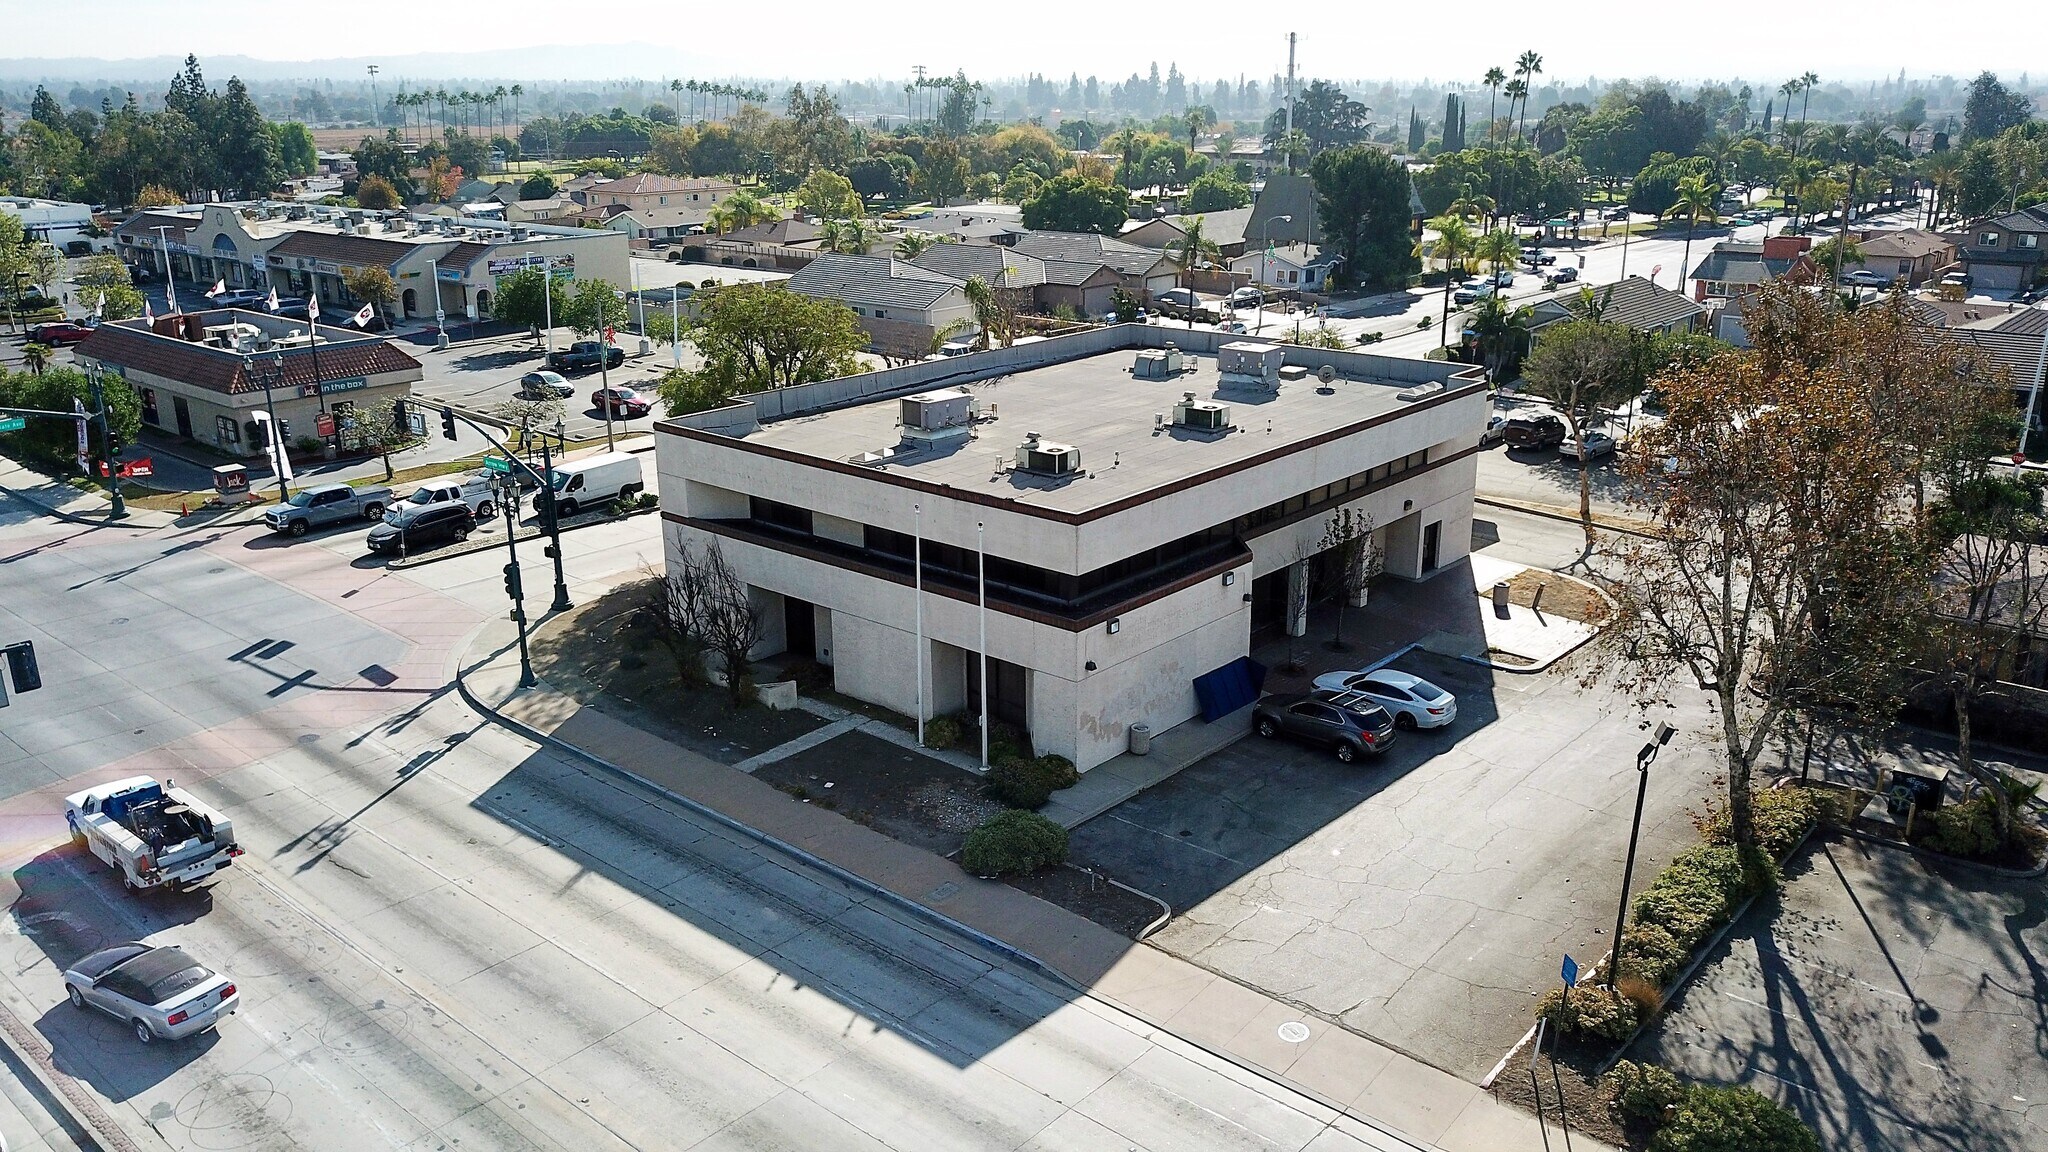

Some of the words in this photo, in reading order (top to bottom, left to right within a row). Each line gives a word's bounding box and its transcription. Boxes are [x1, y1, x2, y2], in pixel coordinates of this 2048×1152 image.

[331, 383, 346, 391] the
[347, 380, 364, 388] box
[226, 474, 246, 488] Jack
